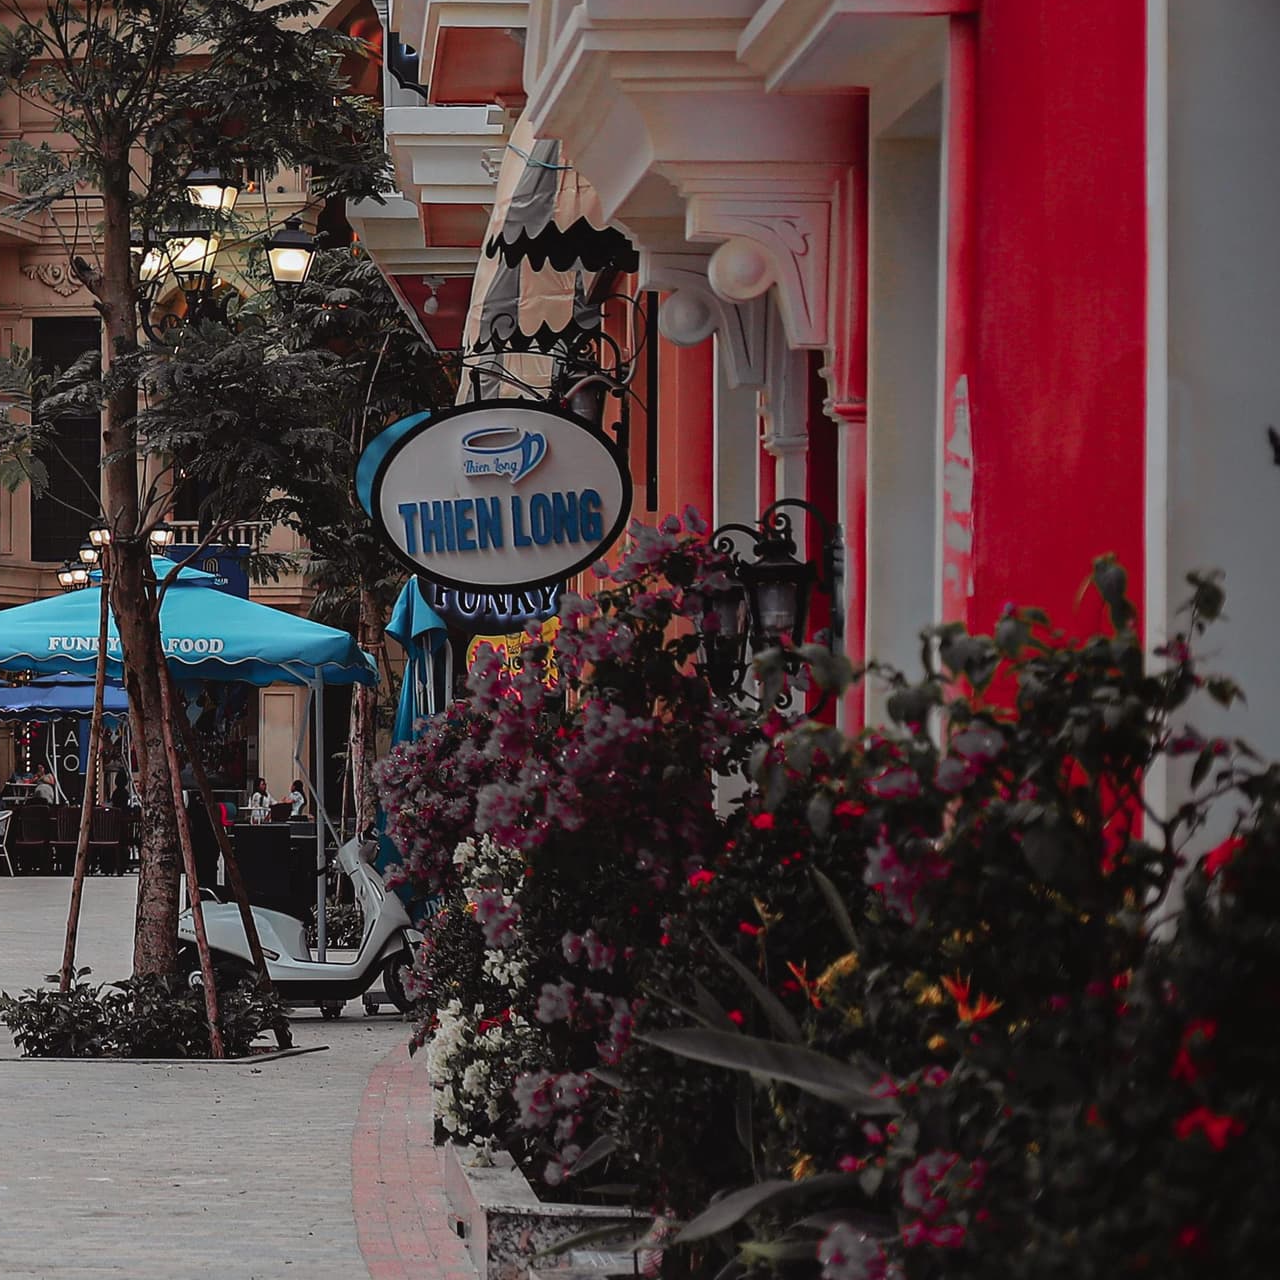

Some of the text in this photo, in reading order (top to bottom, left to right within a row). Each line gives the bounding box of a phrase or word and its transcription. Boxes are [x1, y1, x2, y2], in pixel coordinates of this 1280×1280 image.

[463, 457, 518, 474] Thien Long
[397, 488, 604, 556] THIEN LONG
